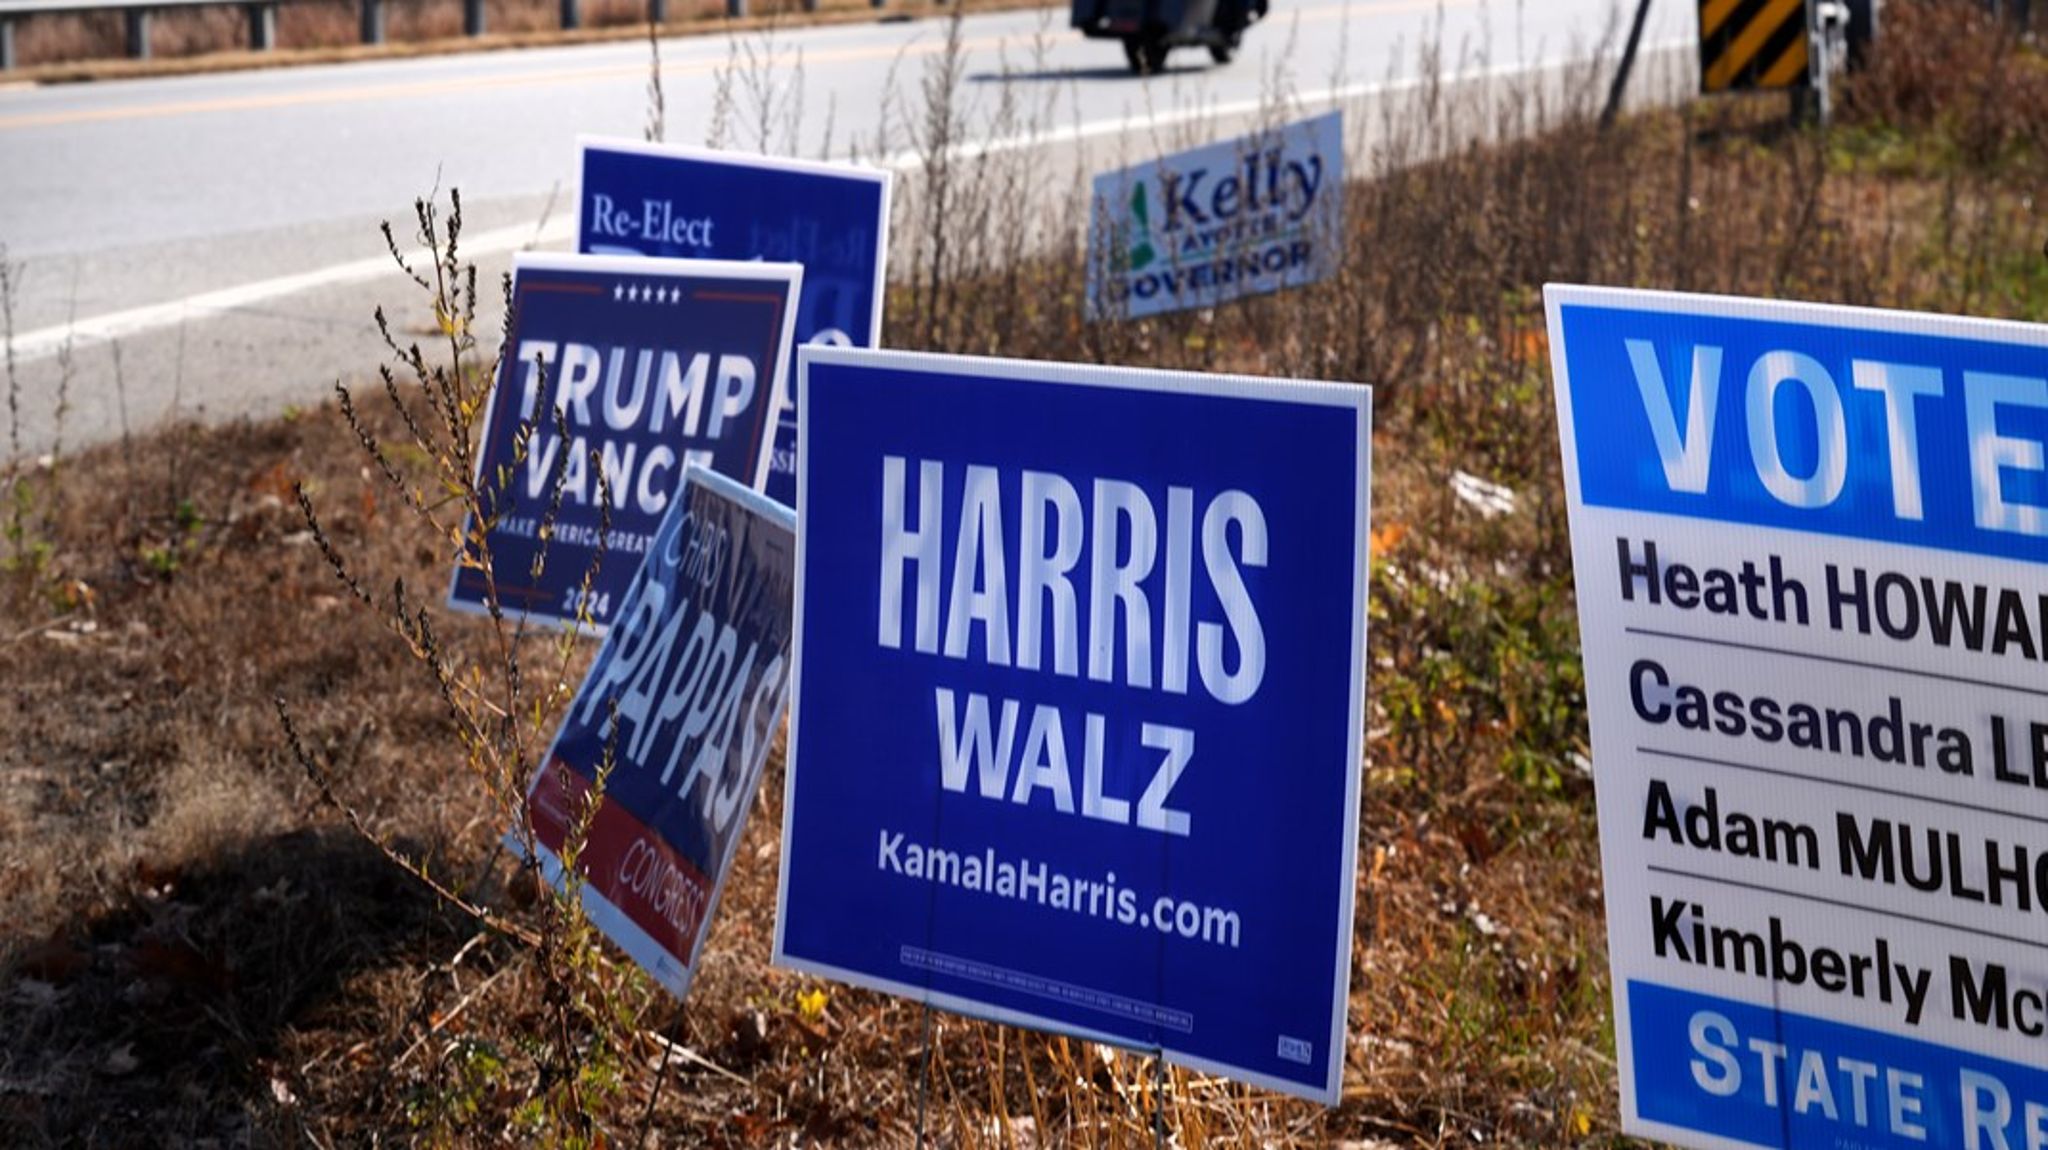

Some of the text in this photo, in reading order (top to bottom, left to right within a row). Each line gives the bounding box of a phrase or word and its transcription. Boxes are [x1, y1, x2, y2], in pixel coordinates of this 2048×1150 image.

[592, 193, 713, 247] Re-Elect
[1160, 148, 1322, 232] Kelly
[1108, 240, 1312, 302] OVERNOR
[518, 340, 756, 439] TRUMP
[1624, 337, 2048, 538] VOTE
[496, 515, 536, 539] MAKE
[540, 522, 602, 548] MERICA
[878, 455, 1268, 705] HARRIS
[1616, 536, 2048, 663] Heath HOWA
[579, 580, 783, 833] PAPPAS
[935, 687, 1195, 836] WALZ
[1629, 658, 1974, 777] Cassandra
[1642, 778, 1820, 870] Adam
[619, 838, 704, 937] CONGRESS
[878, 829, 1241, 948] KamalaHarris.com
[1650, 895, 2048, 1039] Kimberly Mc
[1687, 1010, 1927, 1142] STATE
